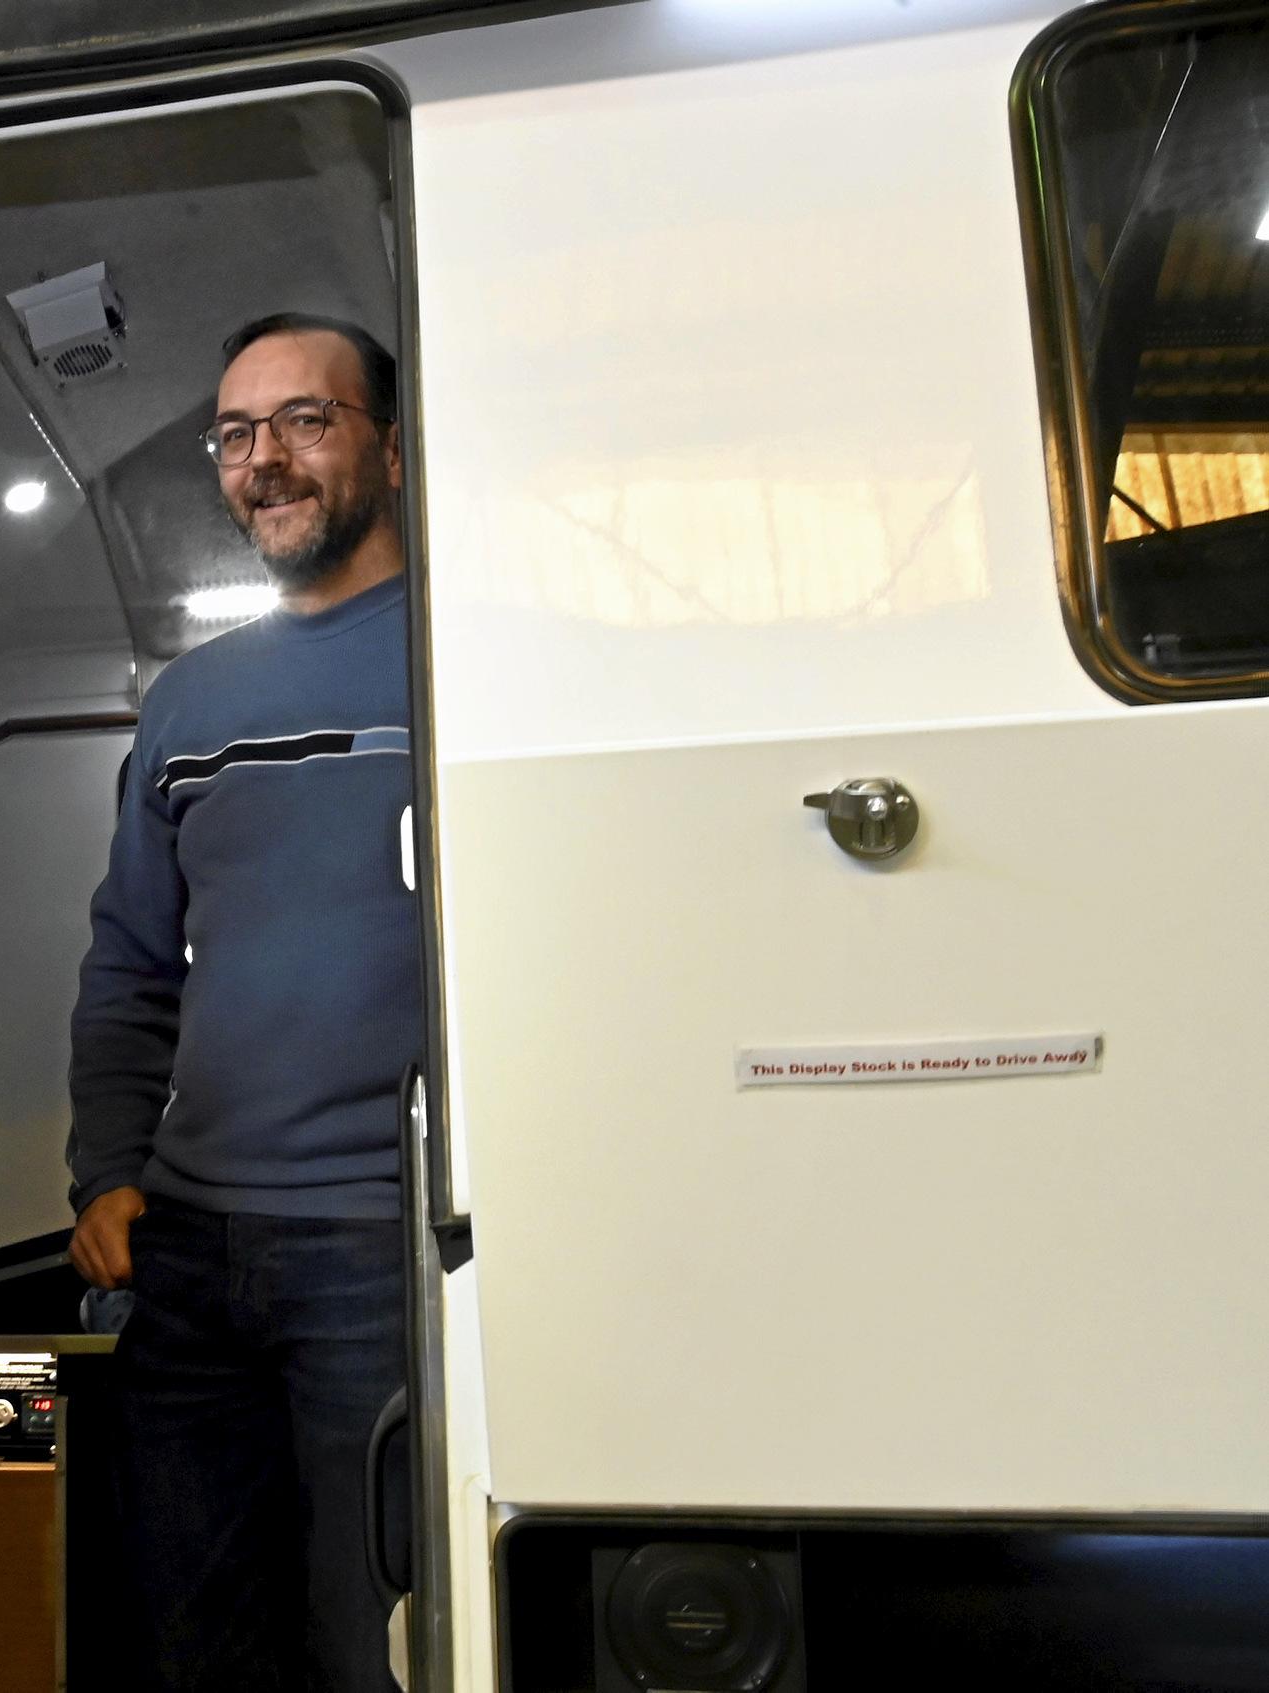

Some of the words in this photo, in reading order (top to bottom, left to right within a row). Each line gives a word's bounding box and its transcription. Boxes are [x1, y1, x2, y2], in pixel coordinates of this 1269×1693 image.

[751, 1064, 784, 1076] This
[789, 1062, 847, 1077] Display
[851, 1060, 897, 1074] Stock
[902, 1059, 916, 1071] is
[920, 1057, 970, 1071] Ready
[975, 1057, 991, 1068] to
[996, 1053, 1038, 1067] Drive
